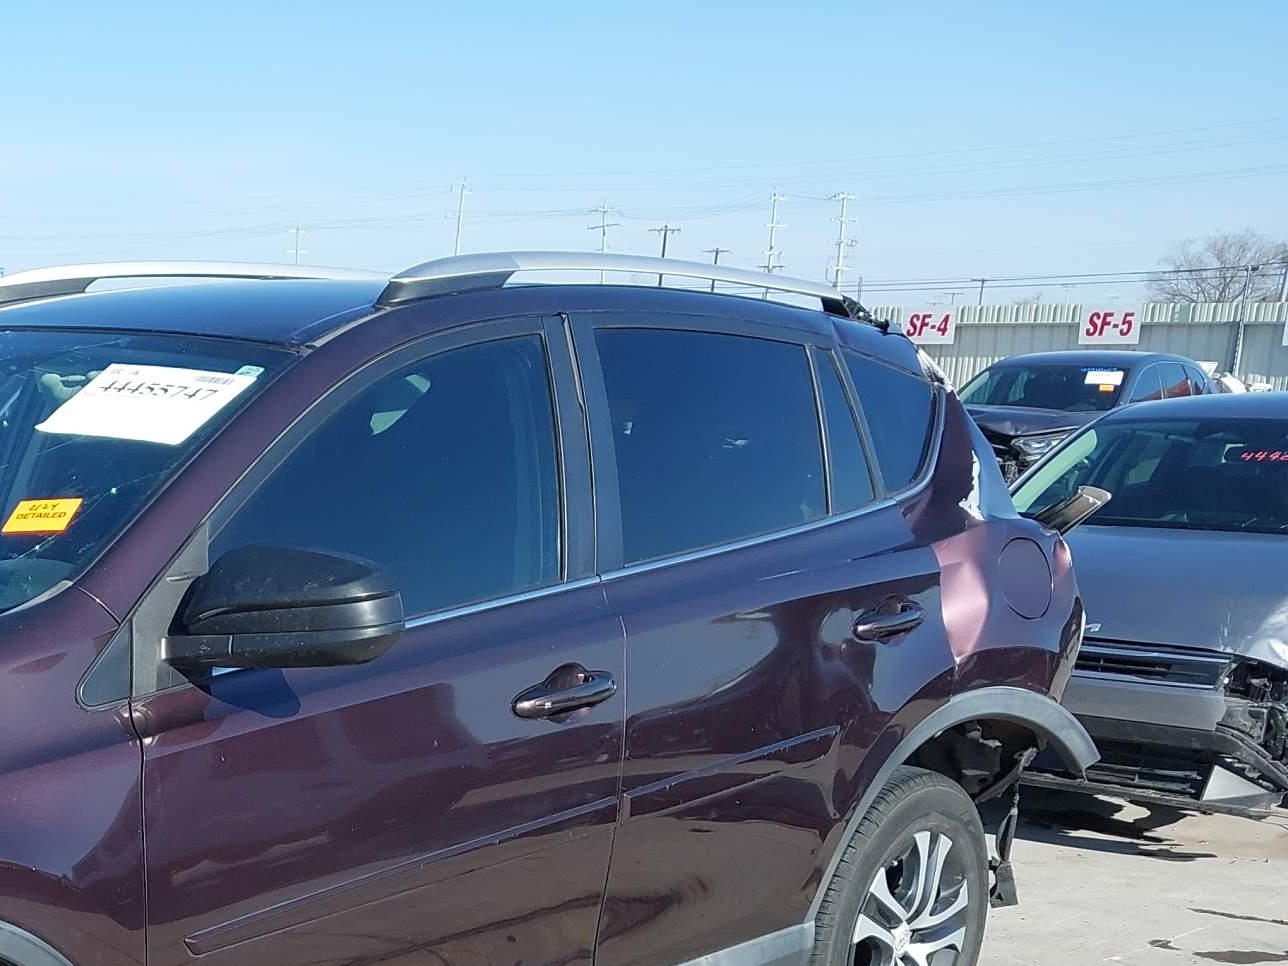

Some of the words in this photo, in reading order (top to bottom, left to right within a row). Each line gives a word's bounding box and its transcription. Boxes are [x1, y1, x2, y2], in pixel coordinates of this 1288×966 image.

[906, 313, 951, 337] SF-4
[1085, 311, 1135, 338] SF-5
[98, 380, 219, 401] 44455747
[15, 511, 67, 520] DETAILED
